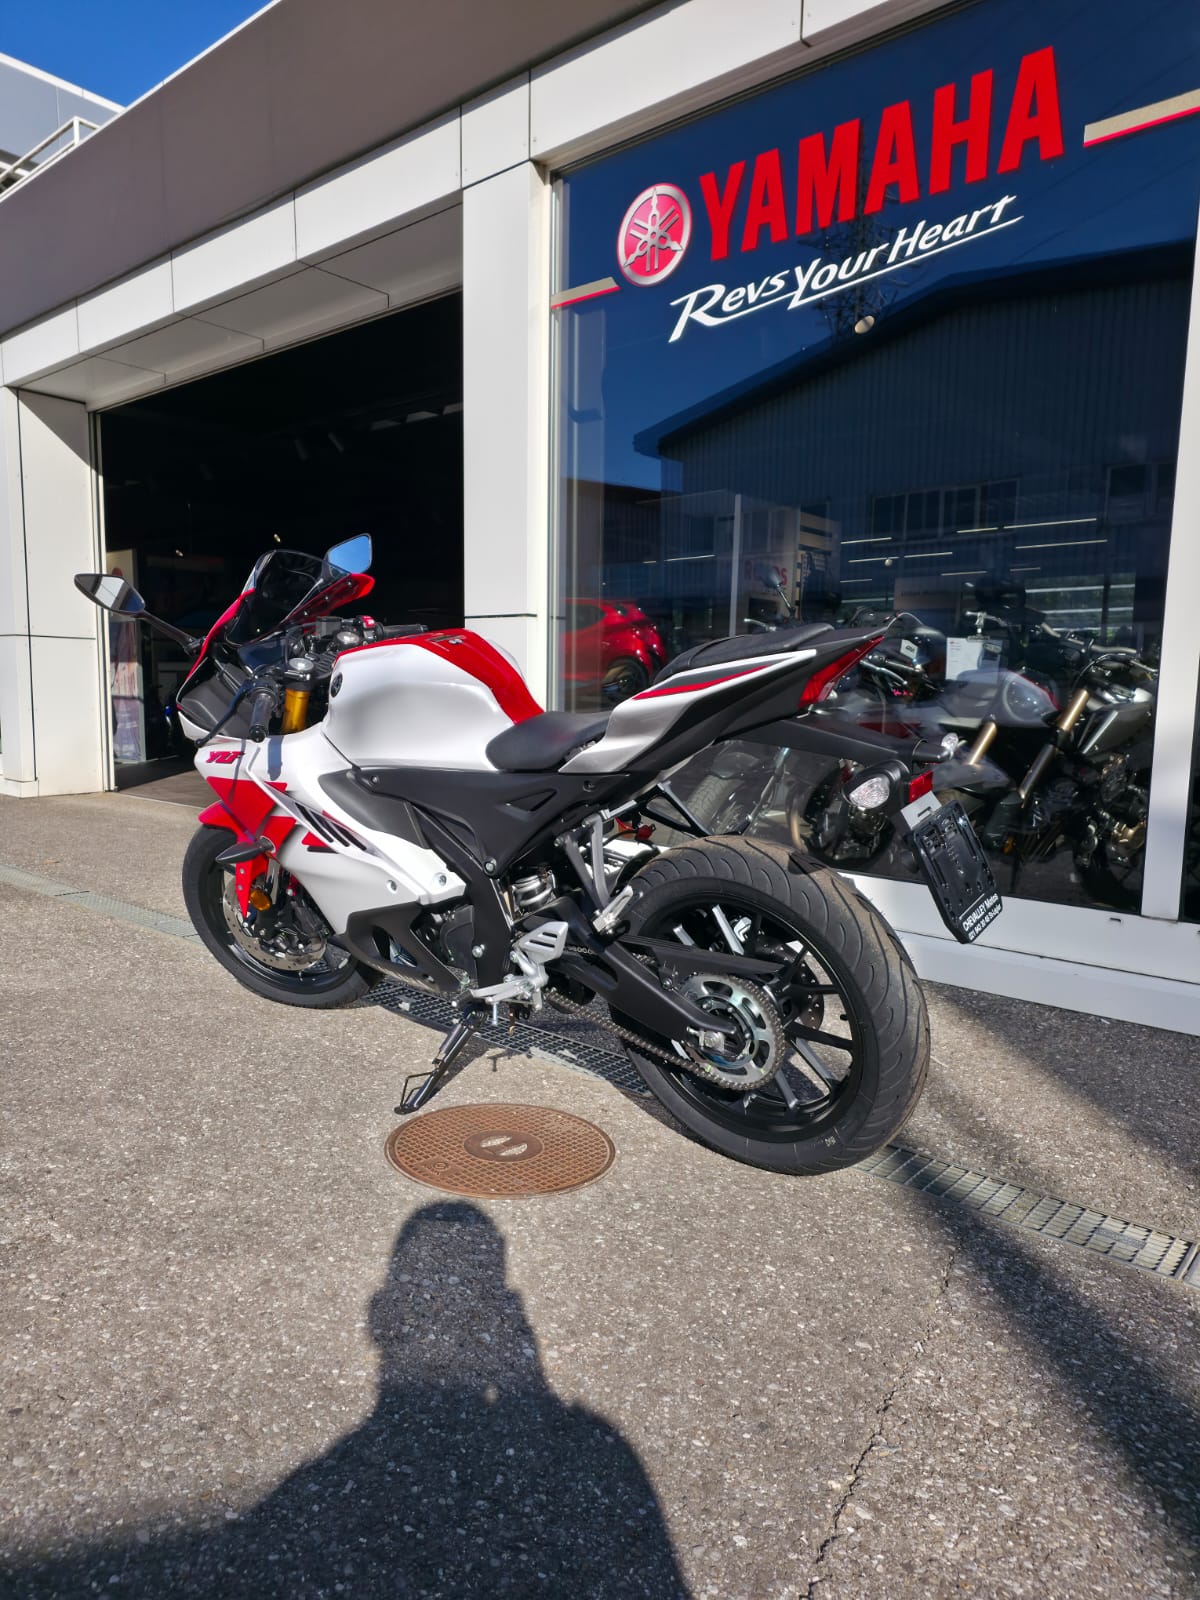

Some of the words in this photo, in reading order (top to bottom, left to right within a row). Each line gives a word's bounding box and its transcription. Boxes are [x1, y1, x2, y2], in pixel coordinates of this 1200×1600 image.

[700, 46, 1063, 260] YAMAHA
[668, 270, 790, 344] Revs
[787, 258, 890, 310] Your
[887, 195, 1017, 263] Heart
[962, 903, 986, 931] CHEVALLEY
